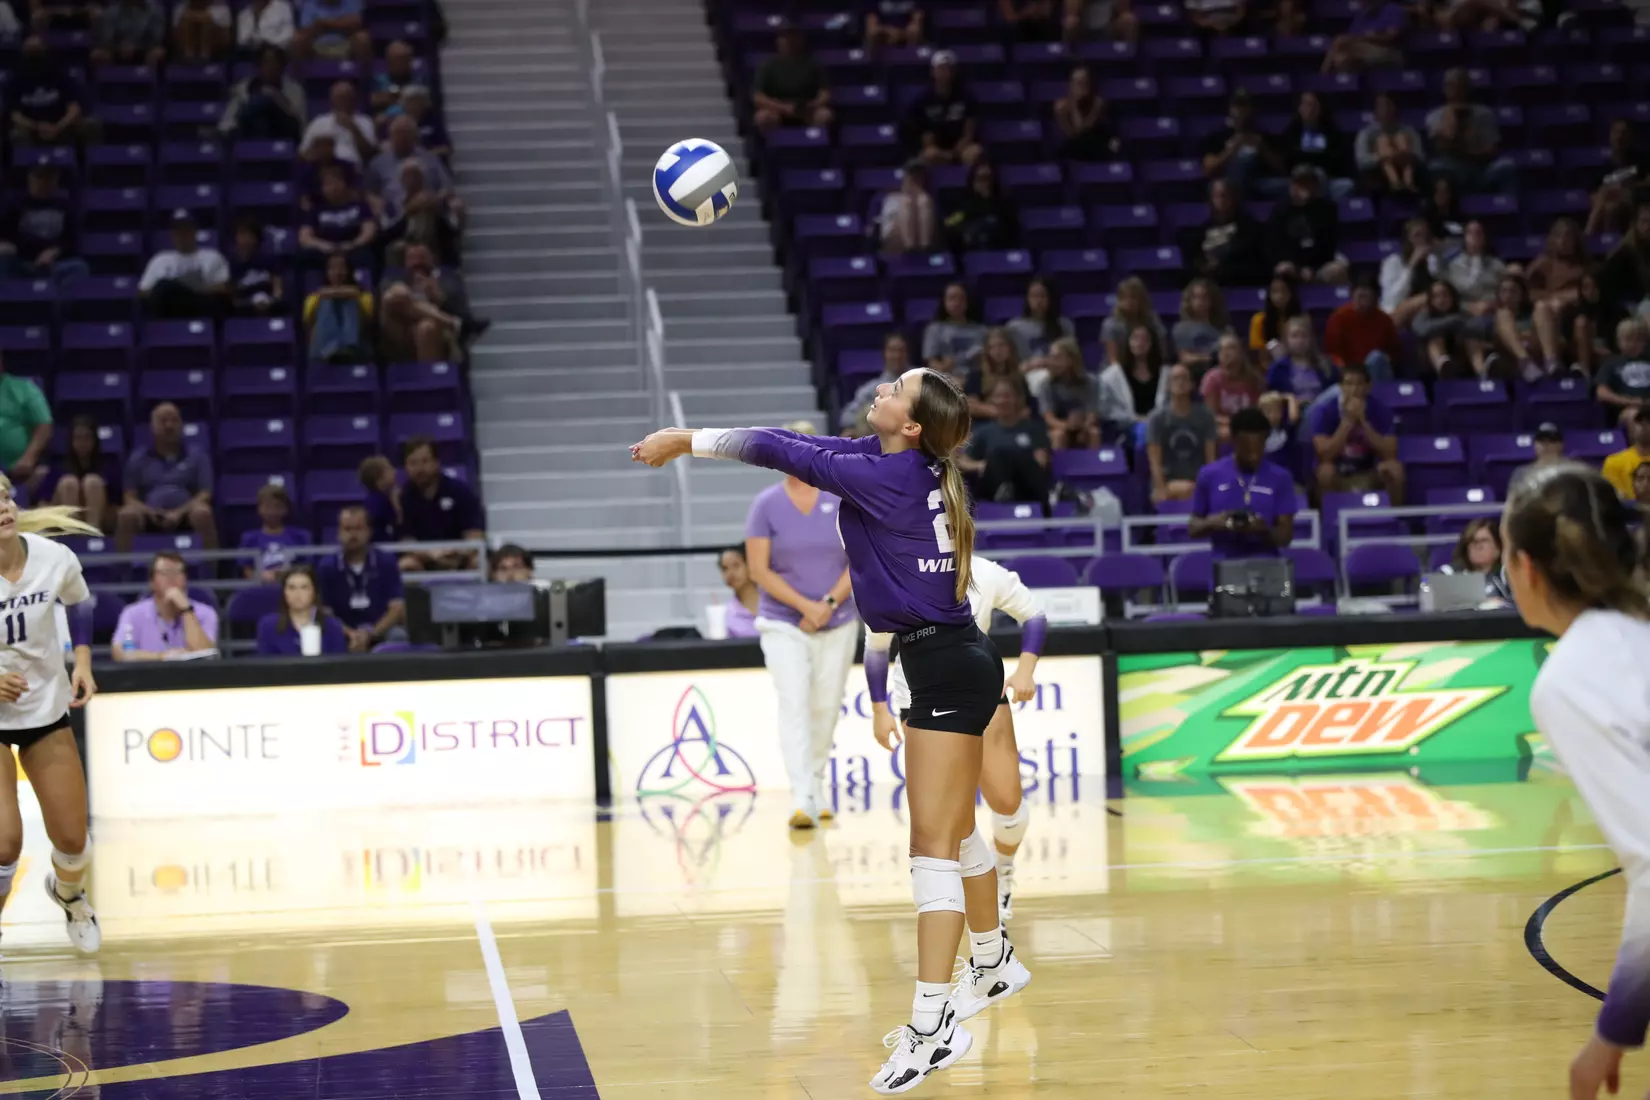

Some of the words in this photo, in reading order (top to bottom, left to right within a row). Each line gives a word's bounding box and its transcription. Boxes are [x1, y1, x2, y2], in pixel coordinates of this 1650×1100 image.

[5, 611, 27, 646] 11
[916, 625, 936, 640] PRO
[123, 722, 284, 765] POINTE
[371, 716, 585, 756] DISTRICT
